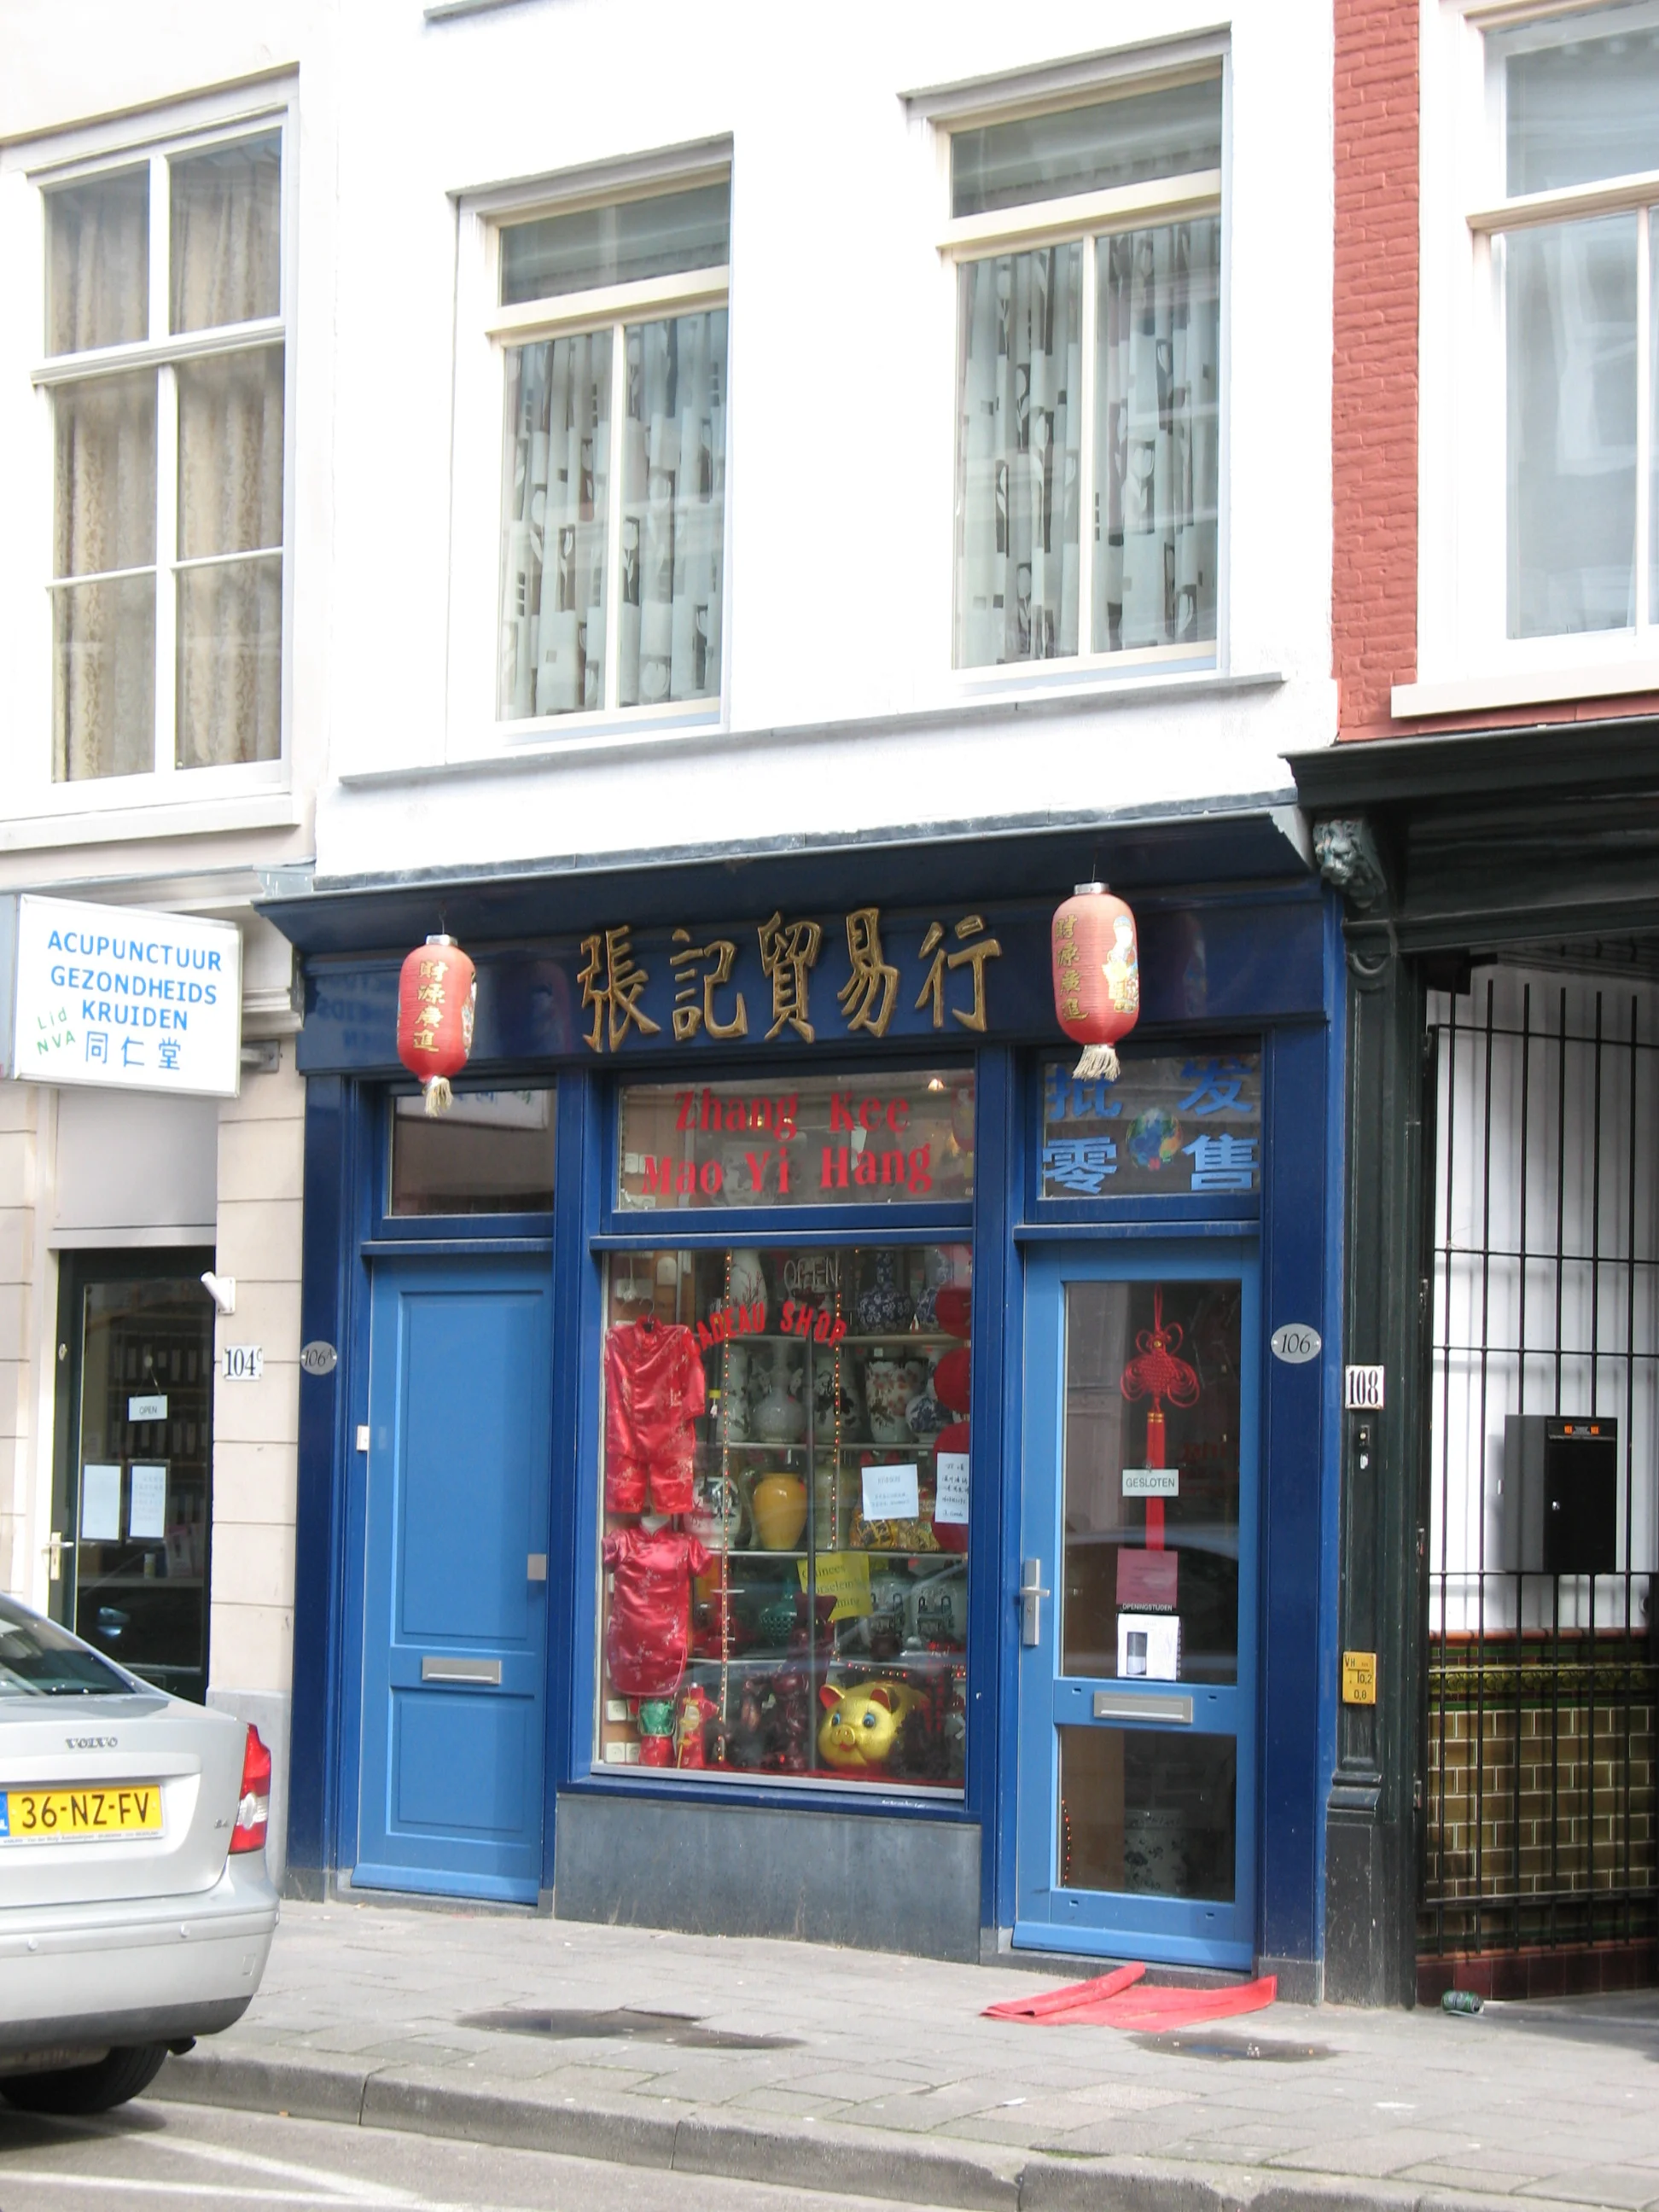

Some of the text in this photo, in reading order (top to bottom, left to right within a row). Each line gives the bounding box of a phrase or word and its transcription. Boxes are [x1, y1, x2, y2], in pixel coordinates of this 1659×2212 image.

[48, 929, 222, 971] ACUPUNCTUUR
[50, 965, 217, 1005] GEZONDHEIDS
[577, 907, 1002, 1054] 張記貿易行
[37, 1006, 67, 1030] Lid
[82, 999, 188, 1031] KRUIDEN
[37, 1030, 76, 1055] NVA
[85, 1031, 181, 1071] 同仁堂
[674, 1087, 911, 1142] Zhang Kee
[641, 1142, 934, 1196] Mao Yi Hang
[780, 1300, 847, 1348] SHOP
[1280, 1333, 1312, 1354] 106
[1348, 1370, 1379, 1406] 108
[139, 1406, 158, 1415] OPEN
[1126, 1477, 1175, 1487] GESLOTEN
[1122, 1604, 1173, 1612] OPENINGSTIJDEN
[65, 1737, 118, 1749] VOLVO
[21, 1792, 149, 1829] 36-NZ-FV
